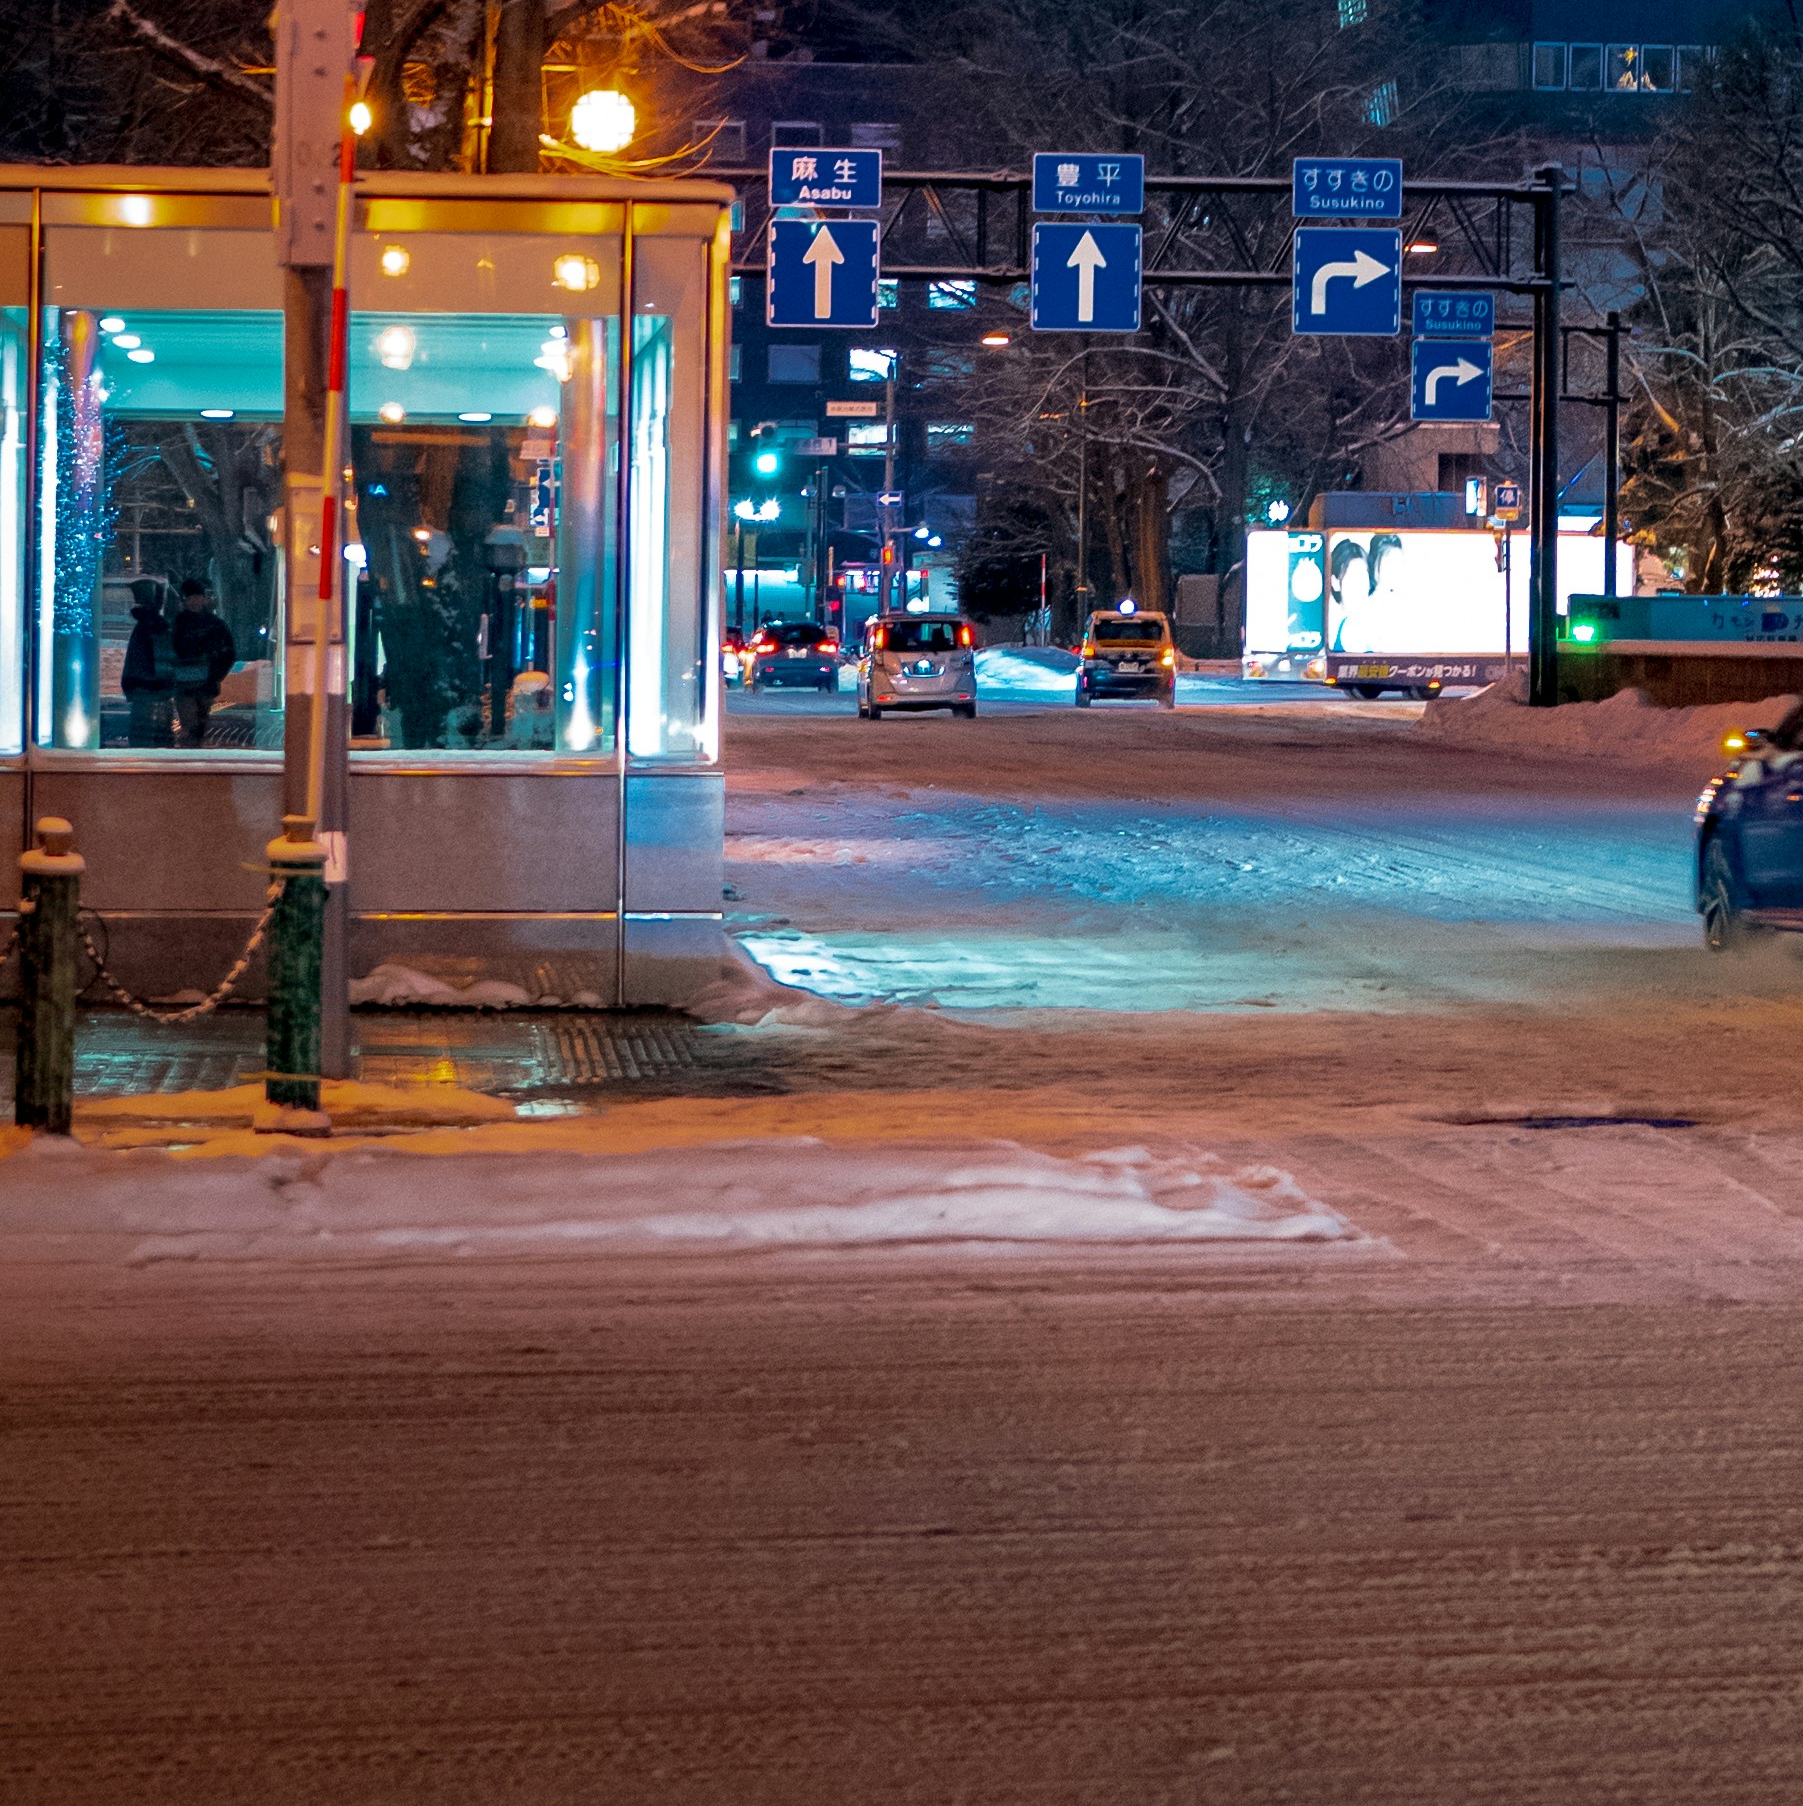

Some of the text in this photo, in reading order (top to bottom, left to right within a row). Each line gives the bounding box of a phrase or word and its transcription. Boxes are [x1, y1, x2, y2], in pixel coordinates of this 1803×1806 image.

[1302, 166, 1394, 192] すすきの
[799, 185, 852, 200] Asabu
[1056, 190, 1121, 207] Toyohira
[1310, 194, 1385, 209] Susukino
[1419, 297, 1489, 318] すすきの
[1425, 318, 1482, 330] Susukino
